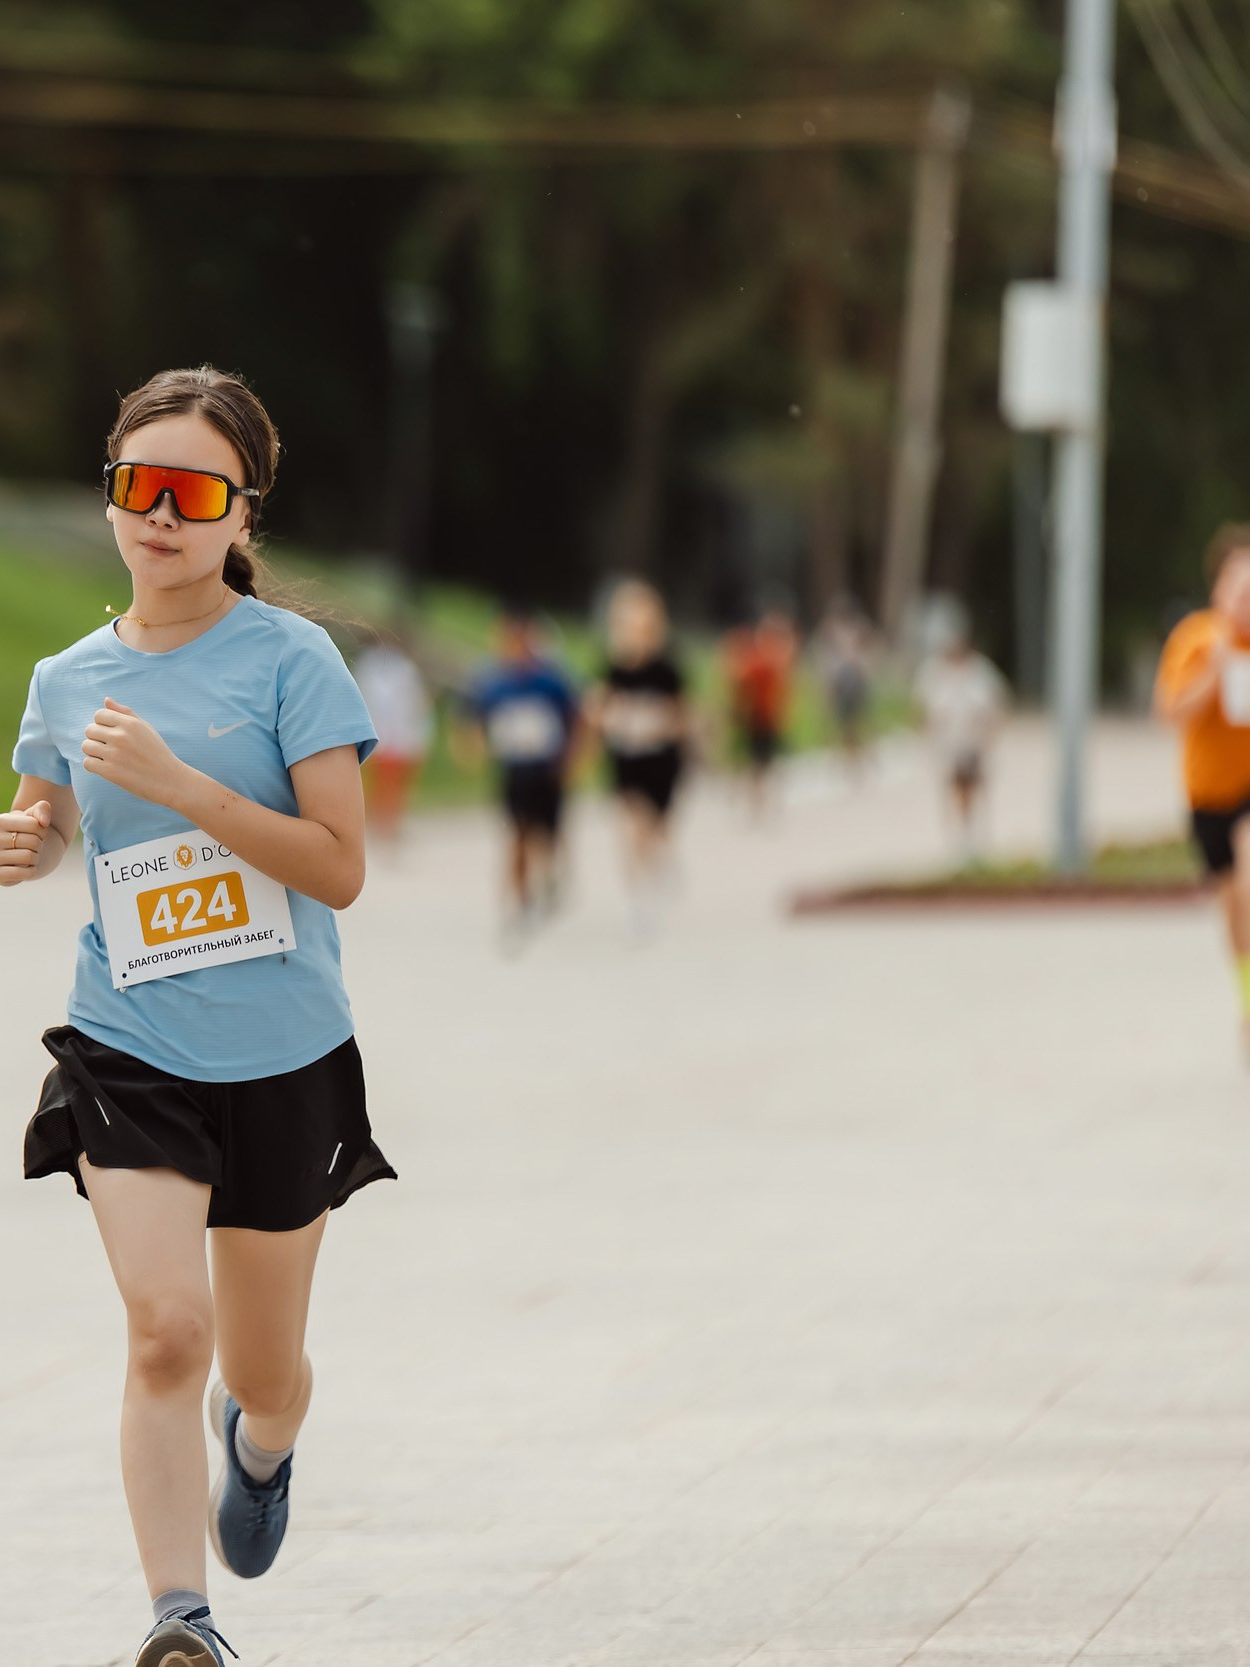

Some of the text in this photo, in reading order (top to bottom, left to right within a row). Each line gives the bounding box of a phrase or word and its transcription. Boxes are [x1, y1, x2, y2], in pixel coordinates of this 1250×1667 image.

[111, 856, 169, 884] LEONE
[150, 880, 237, 934] 424
[128, 929, 275, 970] БЛАГОТВОРИТЕЛЬНЫЙ ЗАБЕГ
